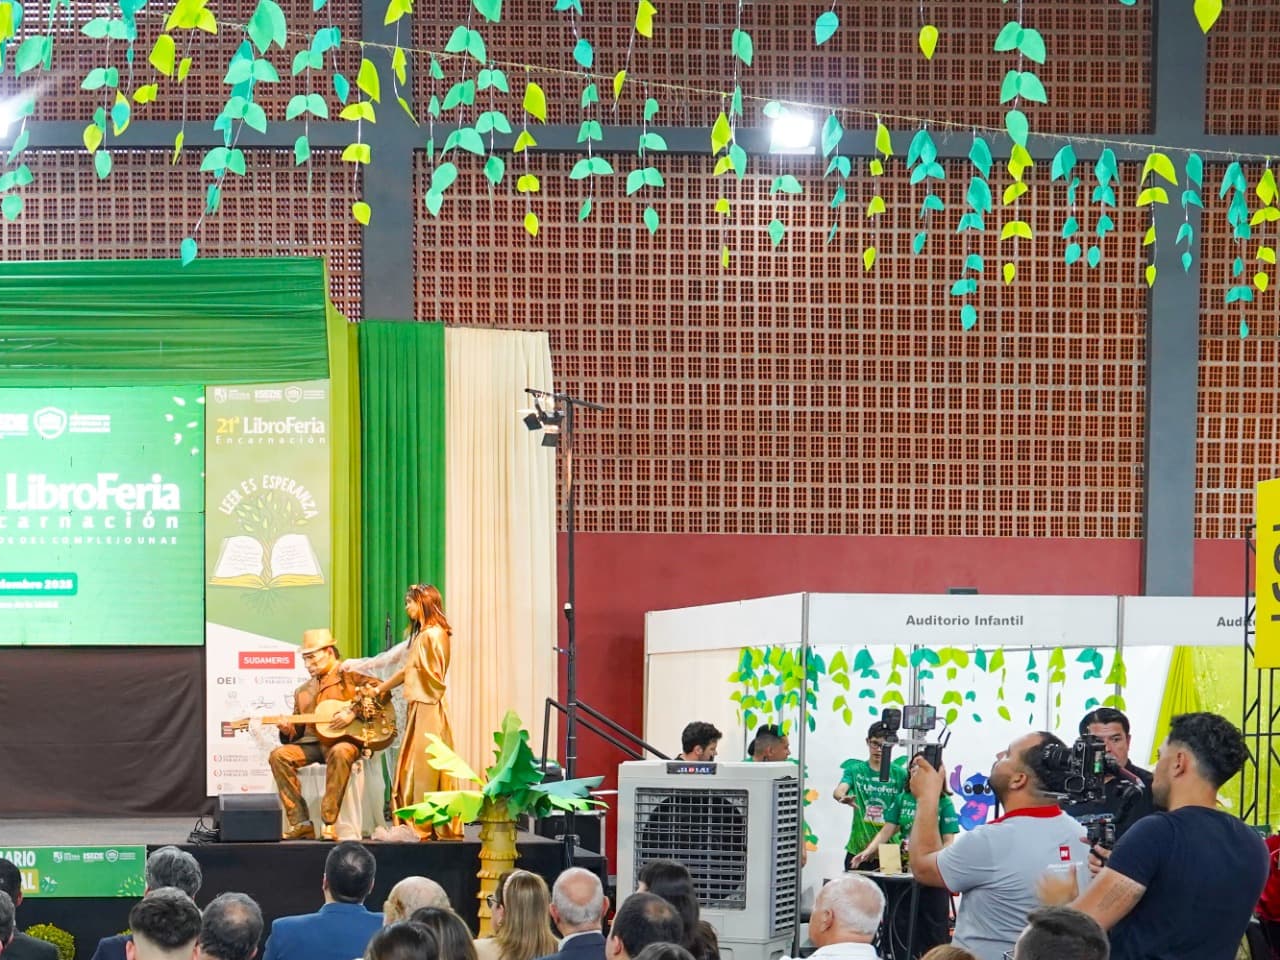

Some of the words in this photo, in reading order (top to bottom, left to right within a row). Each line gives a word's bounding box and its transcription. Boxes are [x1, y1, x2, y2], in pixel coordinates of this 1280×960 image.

[243, 416, 325, 434] LibroFeria
[216, 434, 326, 445] Encarnación
[6, 472, 180, 510] LibroFeria
[218, 489, 243, 515] LEER
[241, 478, 257, 495] ES
[262, 475, 319, 519] ESPERANZA
[906, 614, 970, 626] Auditorio
[974, 614, 1024, 626] Infantil
[243, 656, 290, 665] SUDAMERIS
[217, 676, 236, 685] OEI
